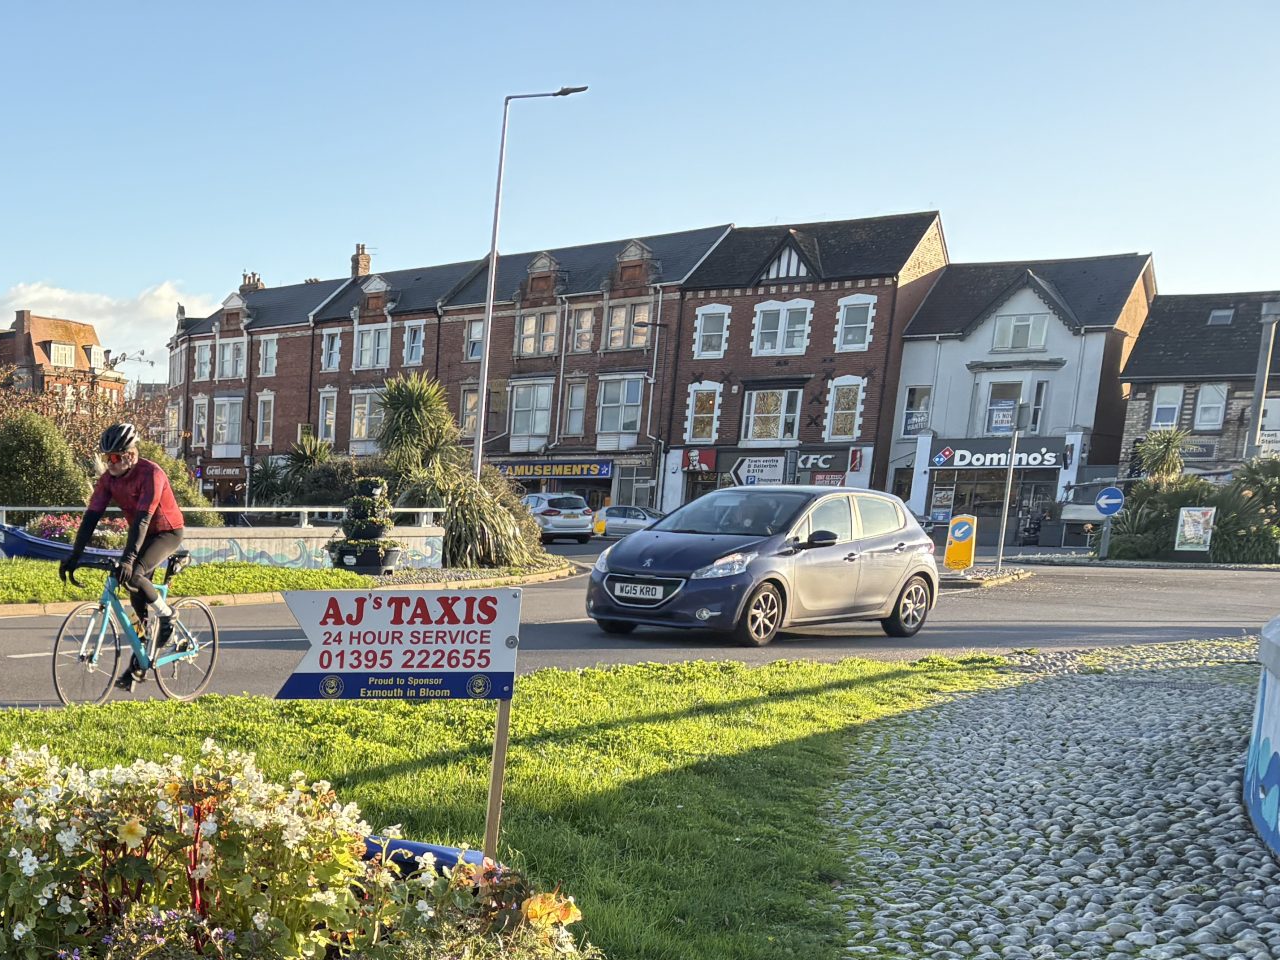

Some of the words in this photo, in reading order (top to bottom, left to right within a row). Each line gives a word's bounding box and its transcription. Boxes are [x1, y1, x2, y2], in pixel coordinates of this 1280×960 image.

[798, 454, 835, 468] KFC
[953, 447, 1057, 466] Domino's
[506, 464, 600, 476] AMUSEMENTS
[620, 583, 638, 595] WG15
[319, 593, 383, 626] AJ's
[386, 596, 498, 625] TAXIS
[322, 631, 343, 646] 24
[349, 631, 404, 645] HOUR
[409, 630, 491, 645] SERVICE
[318, 649, 393, 669] 01395
[401, 649, 491, 669] 222655
[368, 677, 394, 685] Proud
[396, 677, 405, 686] to
[407, 677, 443, 687] Sponsor
[360, 688, 404, 697] Exmouth
[406, 688, 416, 697] in
[419, 688, 451, 697] Bloom
